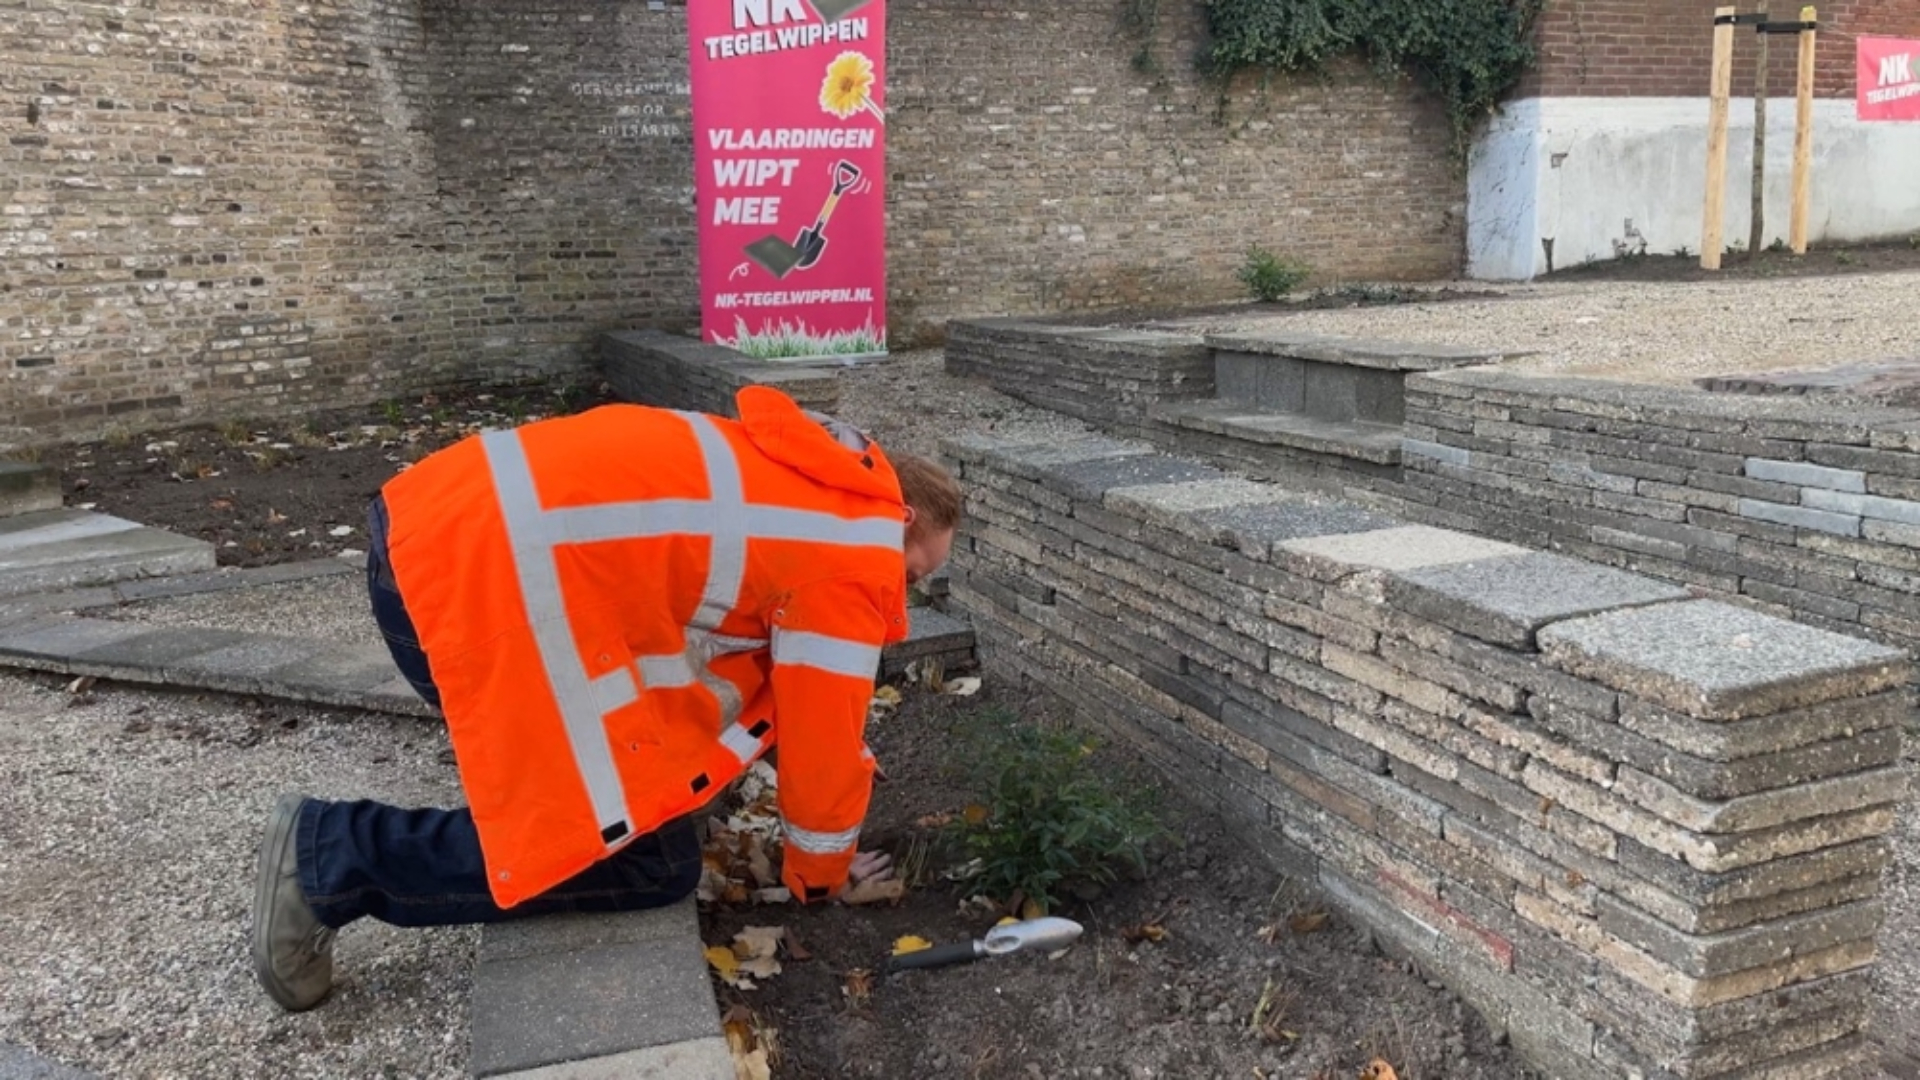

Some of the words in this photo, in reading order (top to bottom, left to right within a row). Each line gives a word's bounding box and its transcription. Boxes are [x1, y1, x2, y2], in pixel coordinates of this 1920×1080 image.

[705, 18, 868, 59] TEGELWIPPEN
[1878, 52, 1910, 85] NK
[709, 129, 874, 149] VLAARDINGEN
[713, 160, 799, 187] WIPT
[714, 197, 780, 225] MEE
[714, 288, 874, 308] NK-TEGELWIPPEN.NL
